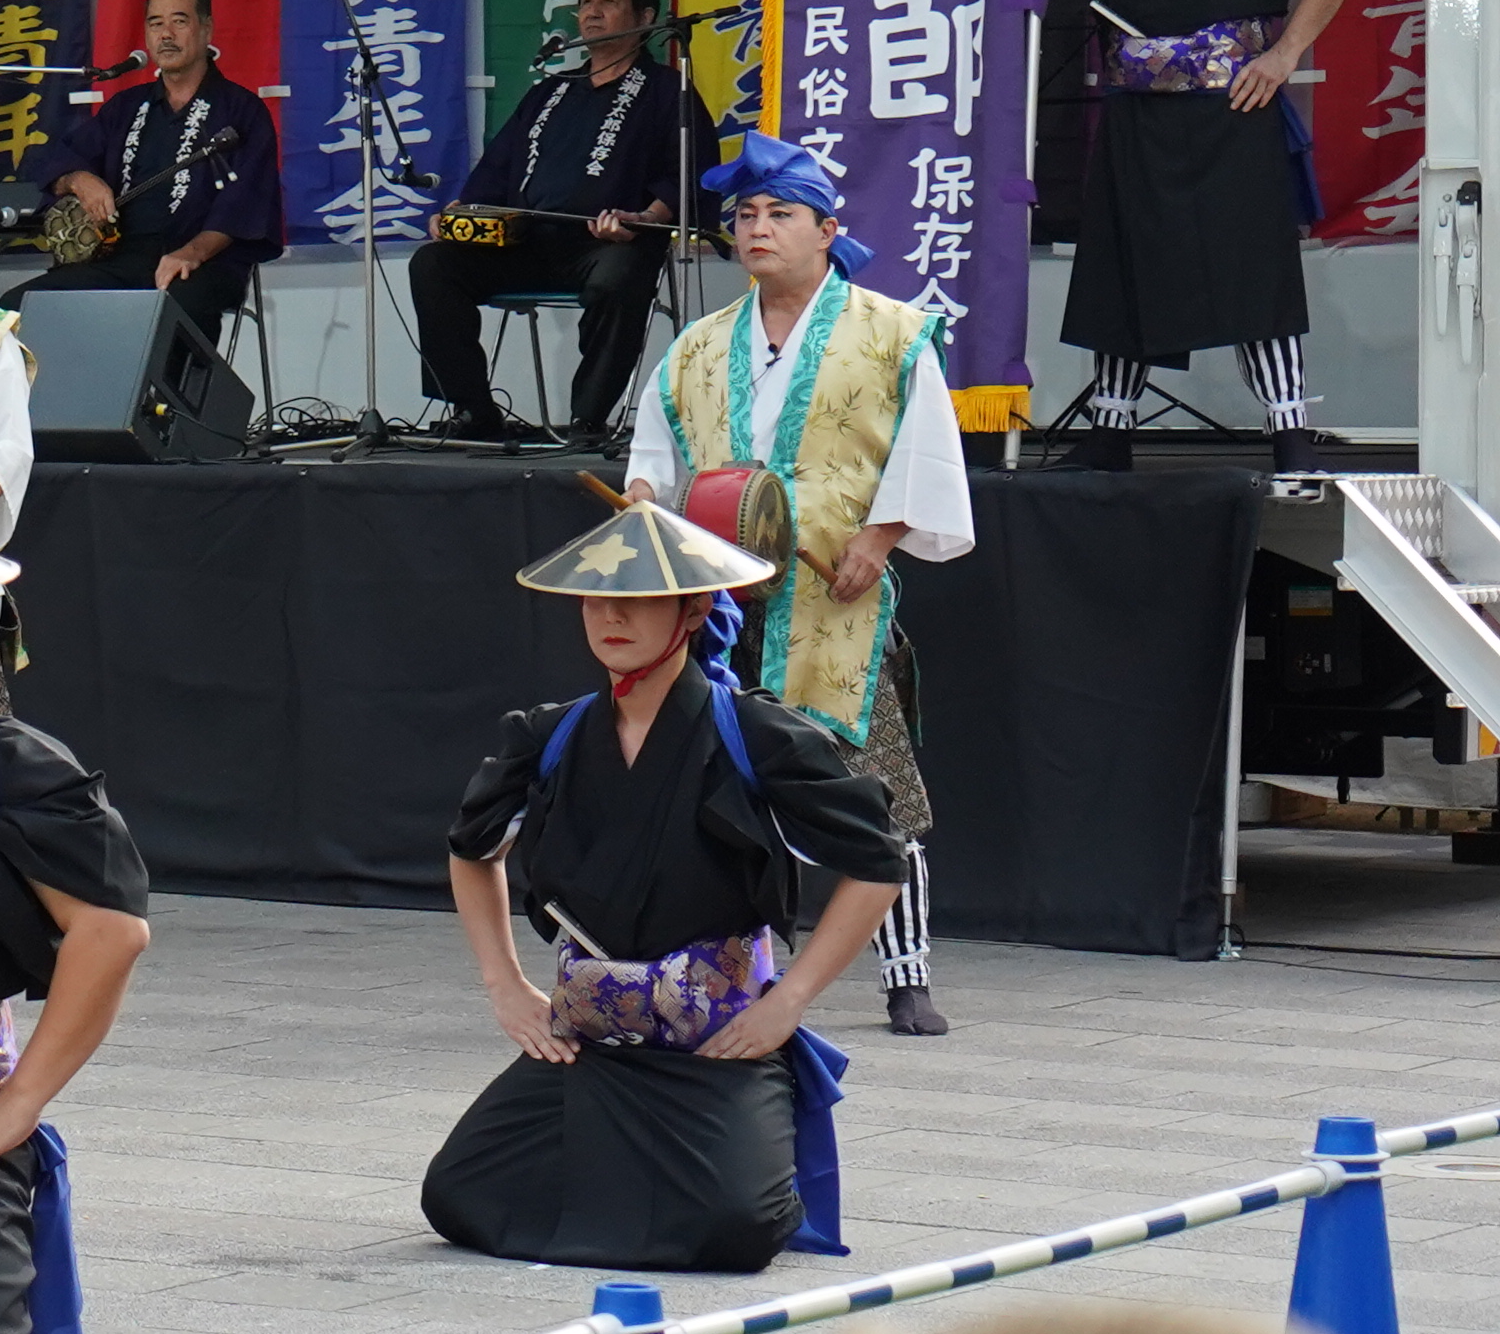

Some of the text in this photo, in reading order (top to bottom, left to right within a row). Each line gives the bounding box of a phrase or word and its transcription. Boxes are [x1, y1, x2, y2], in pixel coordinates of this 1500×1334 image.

[585, 67, 647, 177] 泡瀬京太郎保存会
